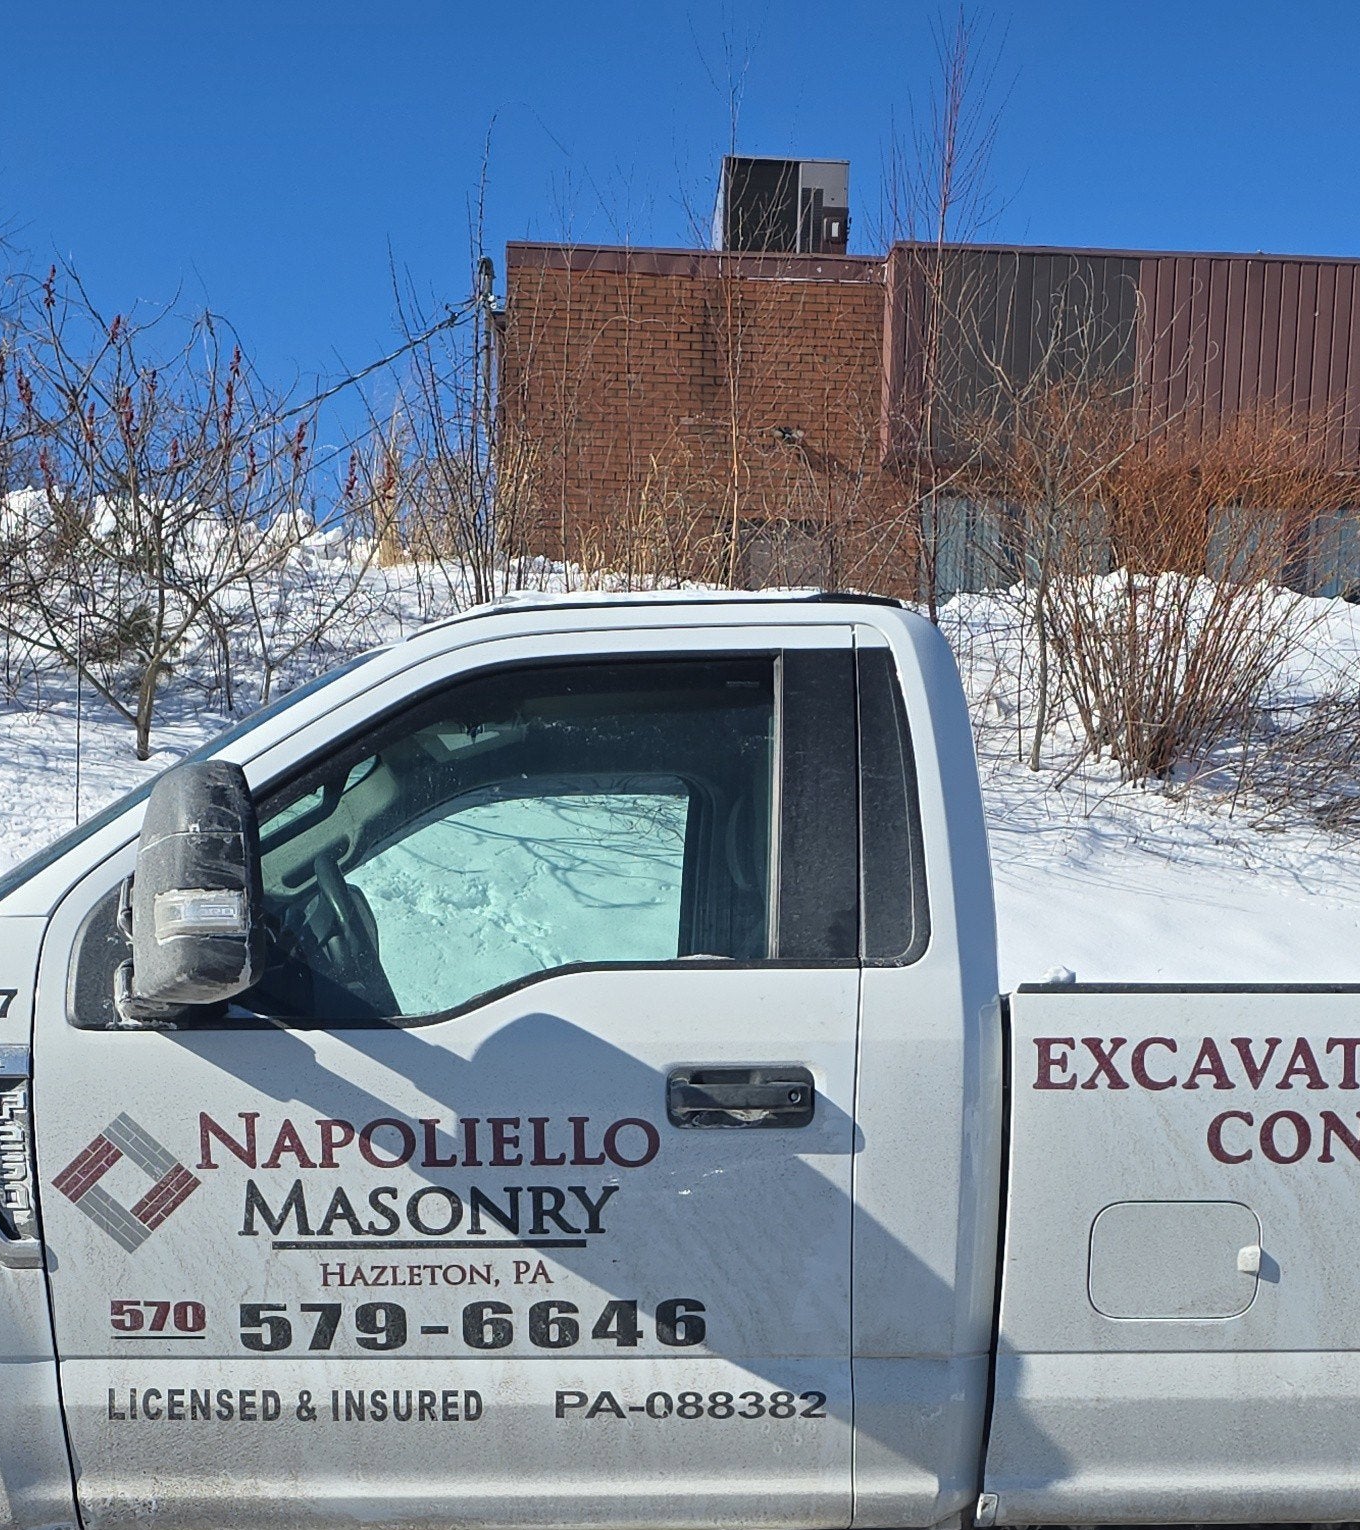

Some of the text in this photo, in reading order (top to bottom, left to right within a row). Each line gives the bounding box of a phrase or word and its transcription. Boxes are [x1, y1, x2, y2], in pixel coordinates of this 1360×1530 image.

[196, 1111, 660, 1169] NAPOLIELLO
[238, 1178, 619, 1237] MASONRY
[320, 1260, 554, 1287] HAZLETON, PA
[111, 1300, 206, 1333] 570
[240, 1298, 707, 1352] 579-6646
[107, 1388, 483, 1423] LICENSED & INSURED
[554, 1391, 827, 1419] PA-088382
